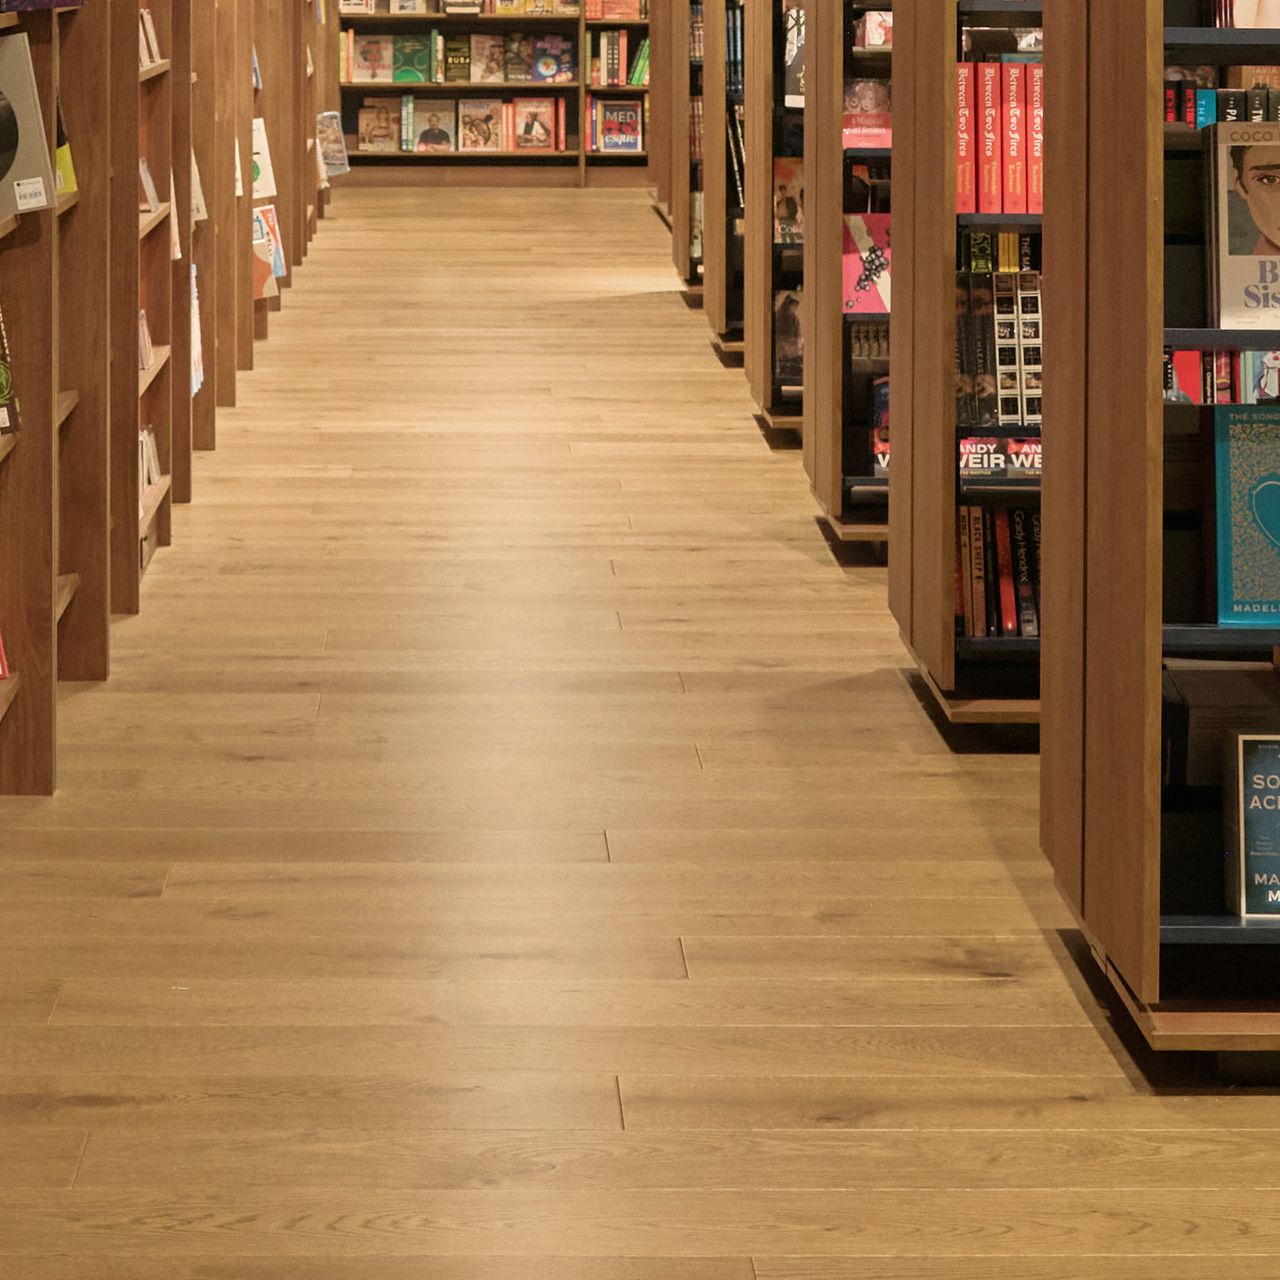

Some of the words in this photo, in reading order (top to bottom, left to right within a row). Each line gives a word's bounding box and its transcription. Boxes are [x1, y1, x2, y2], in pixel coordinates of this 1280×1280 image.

[1230, 131, 1274, 142] COCO
[1228, 413, 1248, 421] THE
[1251, 413, 1280, 421] SONG
